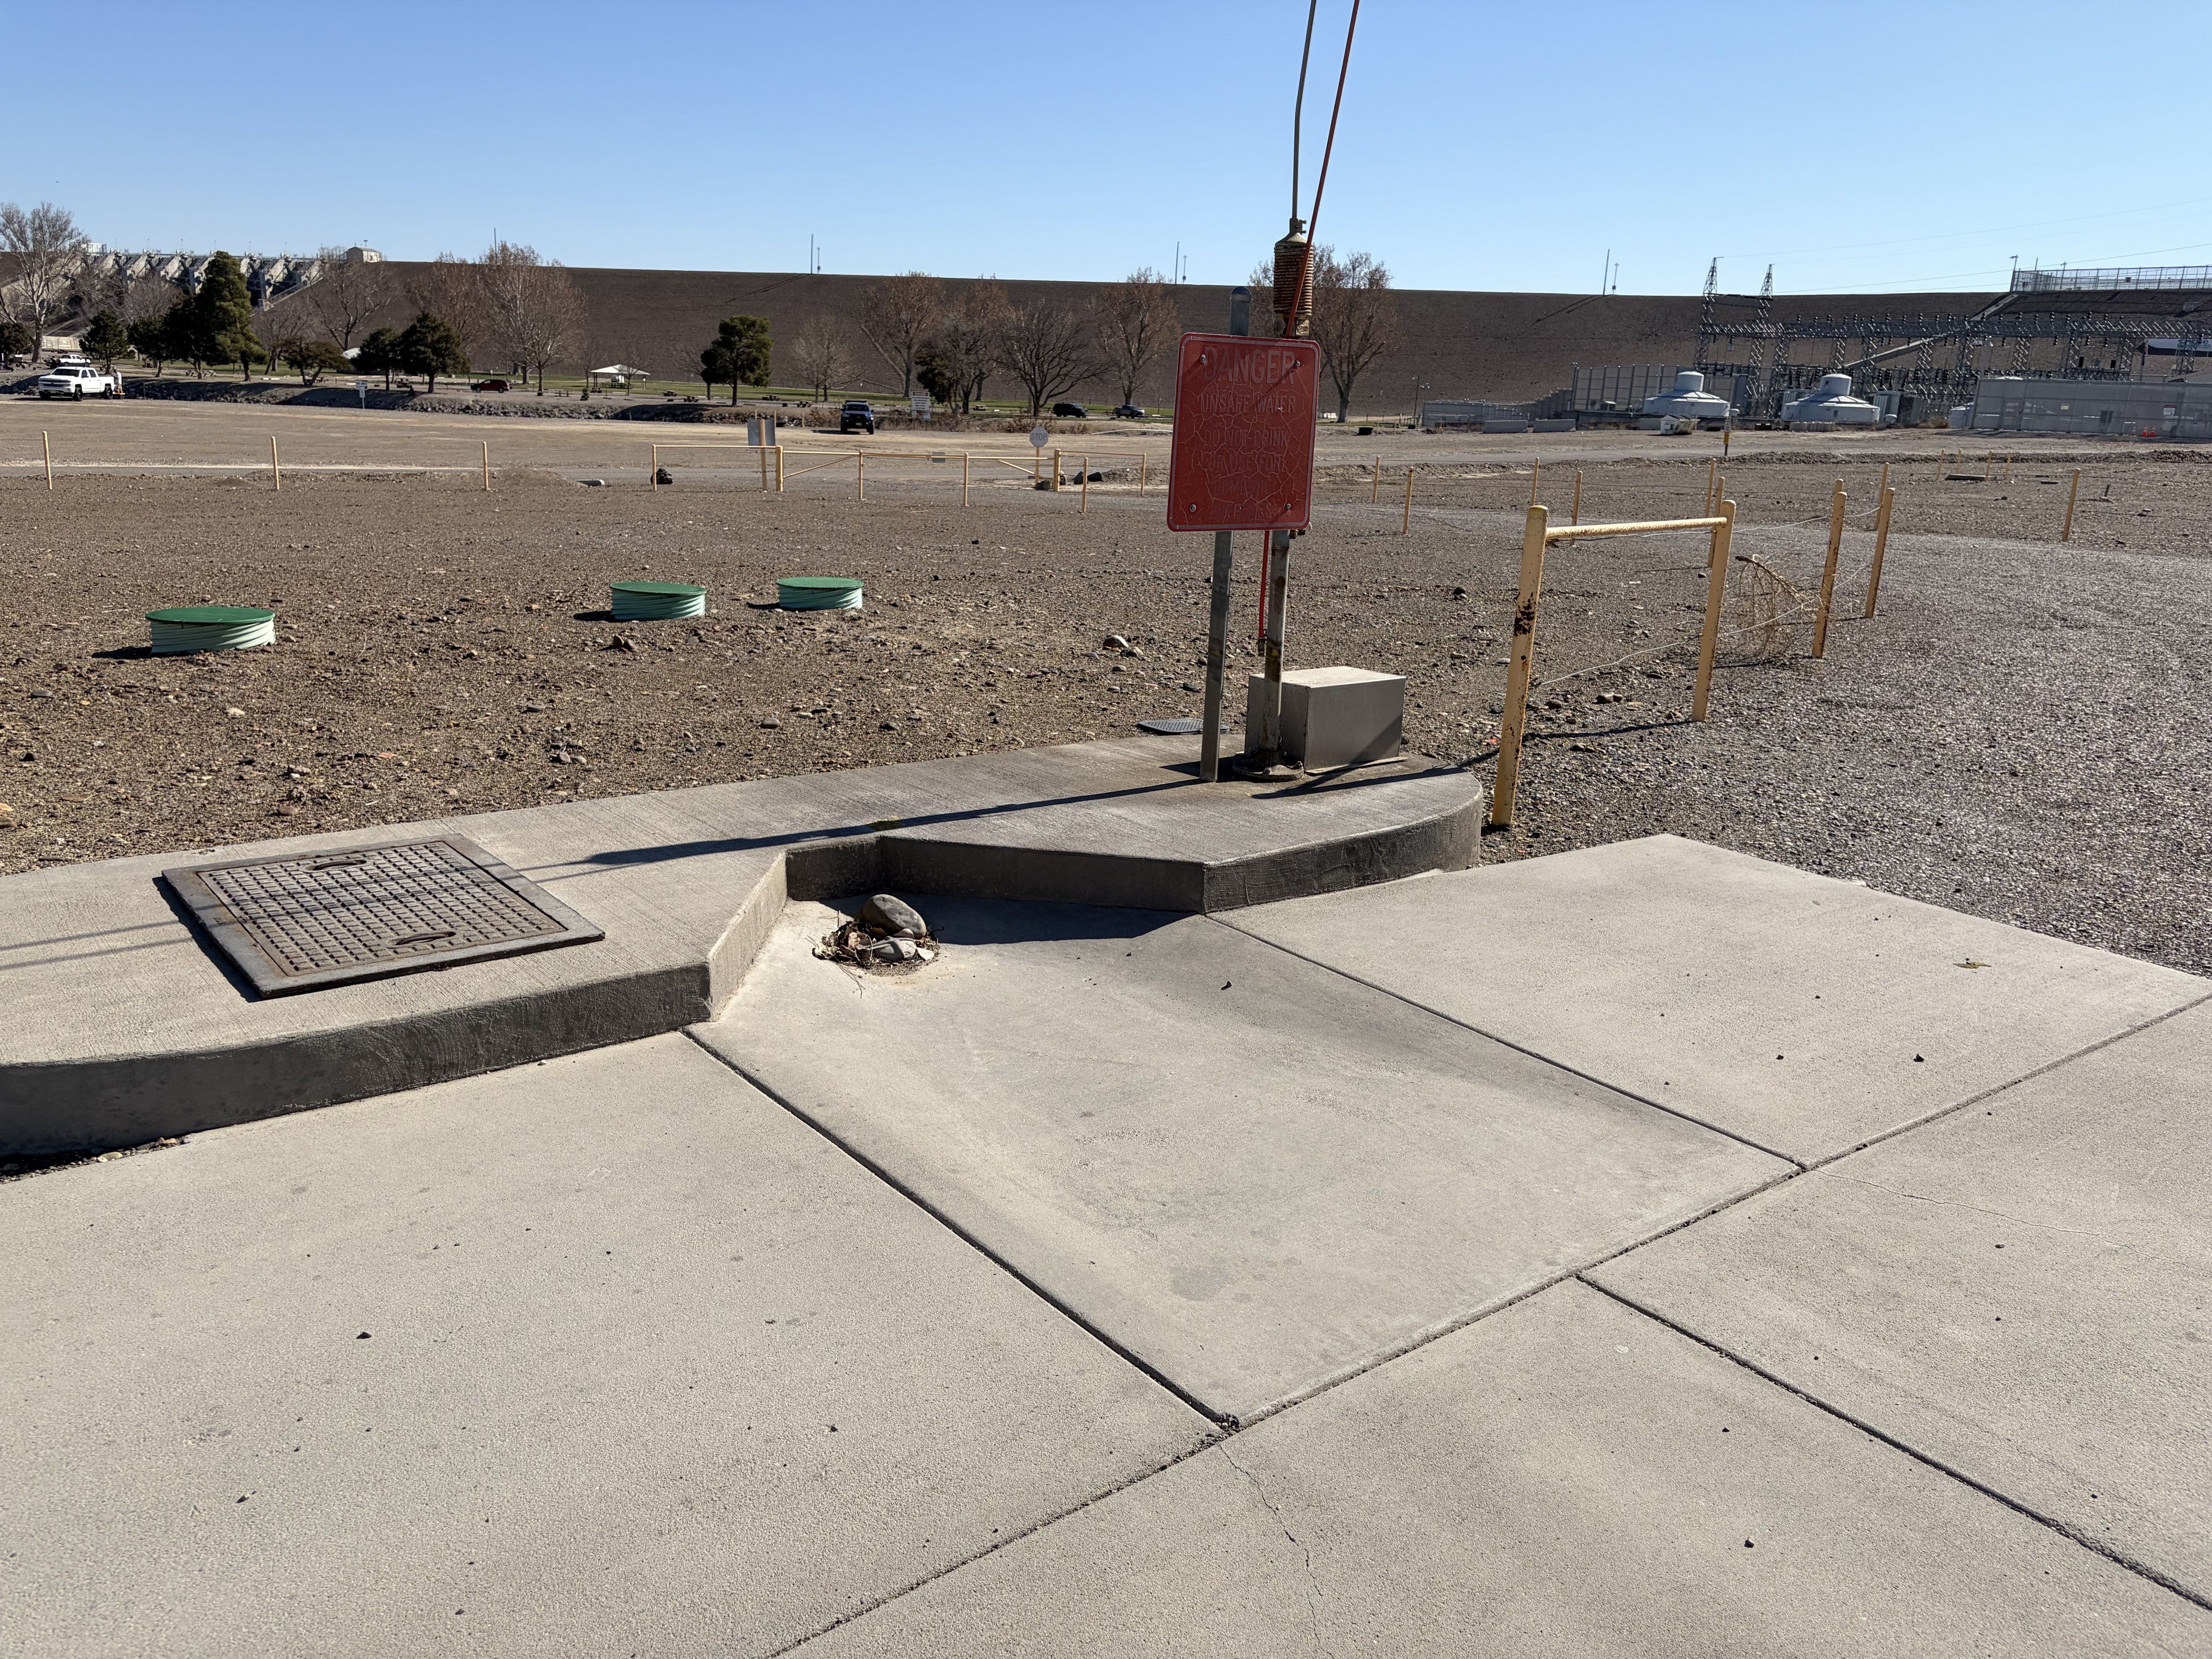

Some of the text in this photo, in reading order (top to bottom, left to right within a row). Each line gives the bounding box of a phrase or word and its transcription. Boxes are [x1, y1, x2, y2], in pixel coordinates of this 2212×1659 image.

[1203, 347, 1295, 385] DANGER
[1201, 394, 1296, 414] UNSAFE WATER
[1204, 429, 1288, 447] DO NOT DRINK
[1209, 454, 1281, 472] OR USE FOR
[1214, 478, 1272, 496] DOMESTIC
